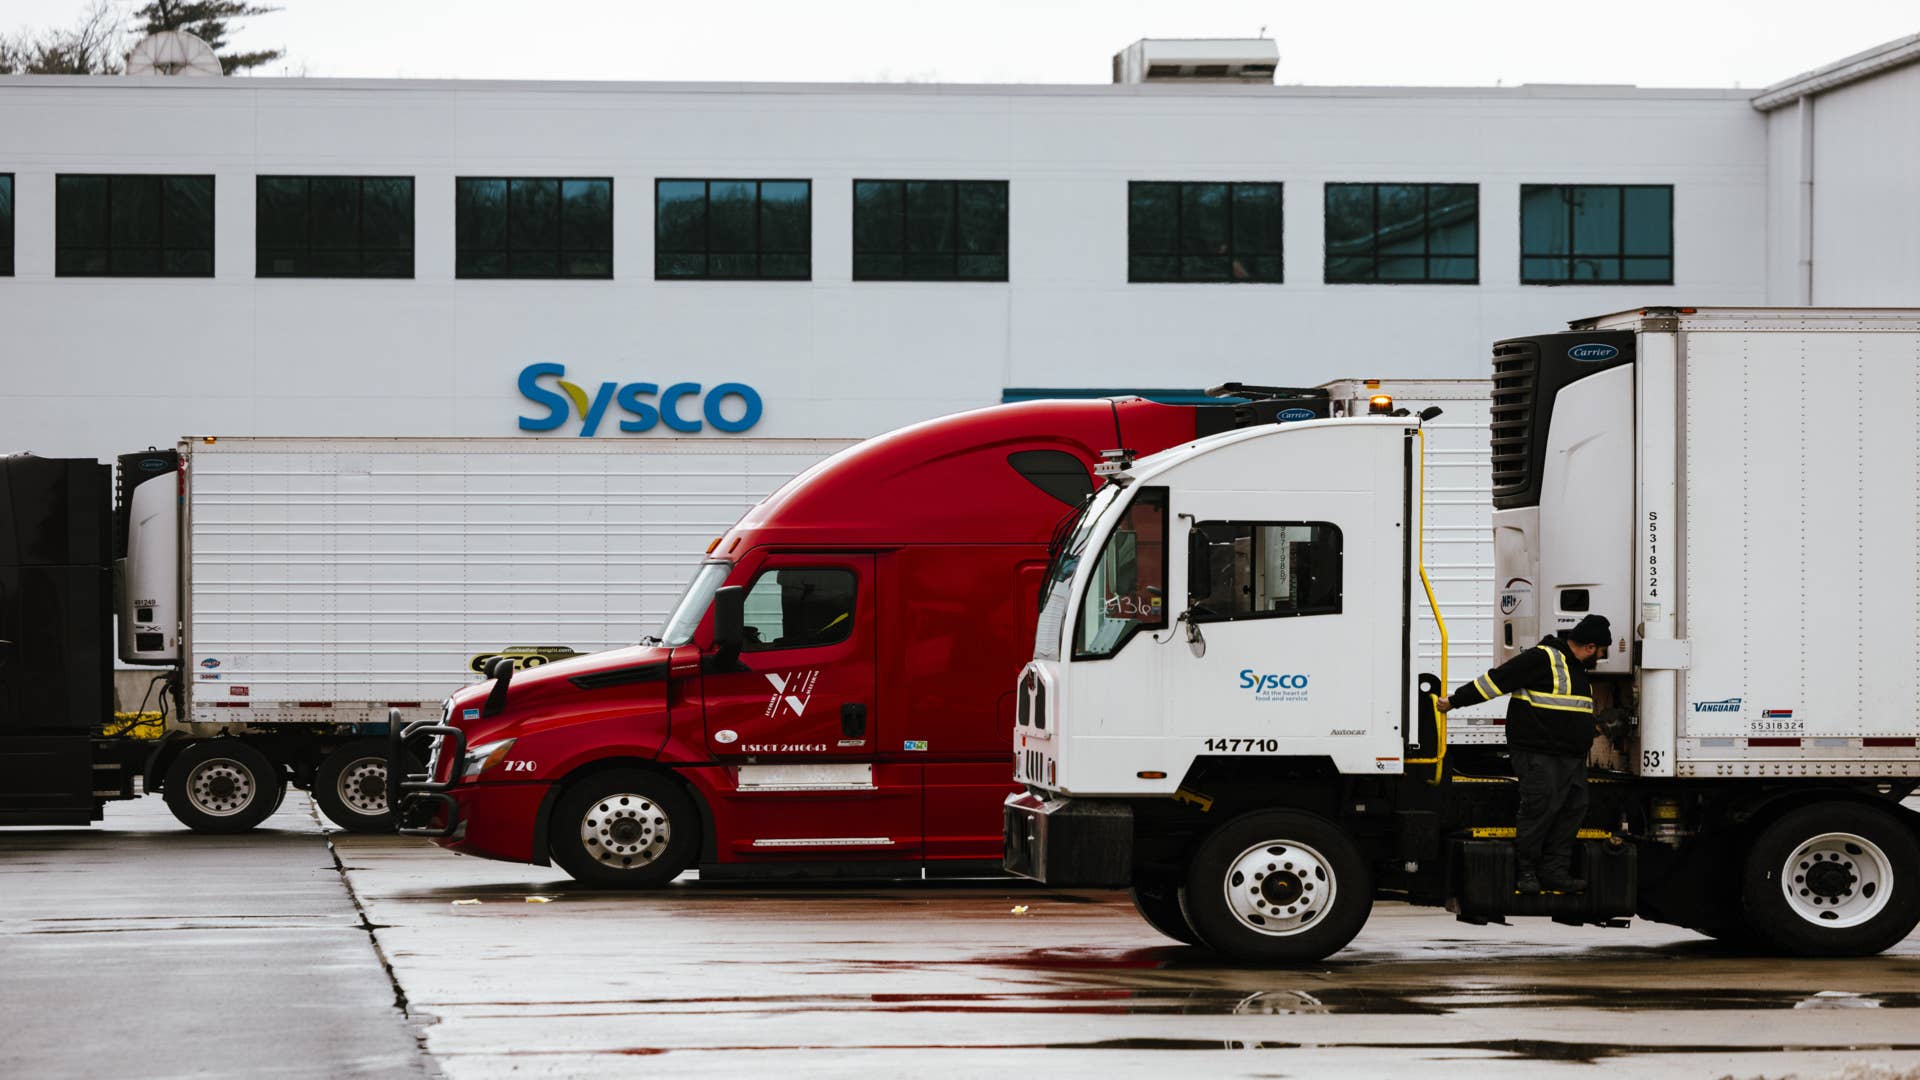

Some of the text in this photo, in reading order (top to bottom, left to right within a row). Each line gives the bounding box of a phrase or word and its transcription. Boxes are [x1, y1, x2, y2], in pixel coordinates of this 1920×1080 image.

[1574, 348, 1612, 357] Carrier
[517, 362, 763, 438] Sysco
[1648, 511, 1658, 597] S5318324
[1240, 669, 1308, 693] Sysco
[1751, 722, 1804, 730] S5318324
[741, 744, 777, 752] USDOT
[1204, 738, 1279, 752] 147710
[503, 760, 537, 771] 720
